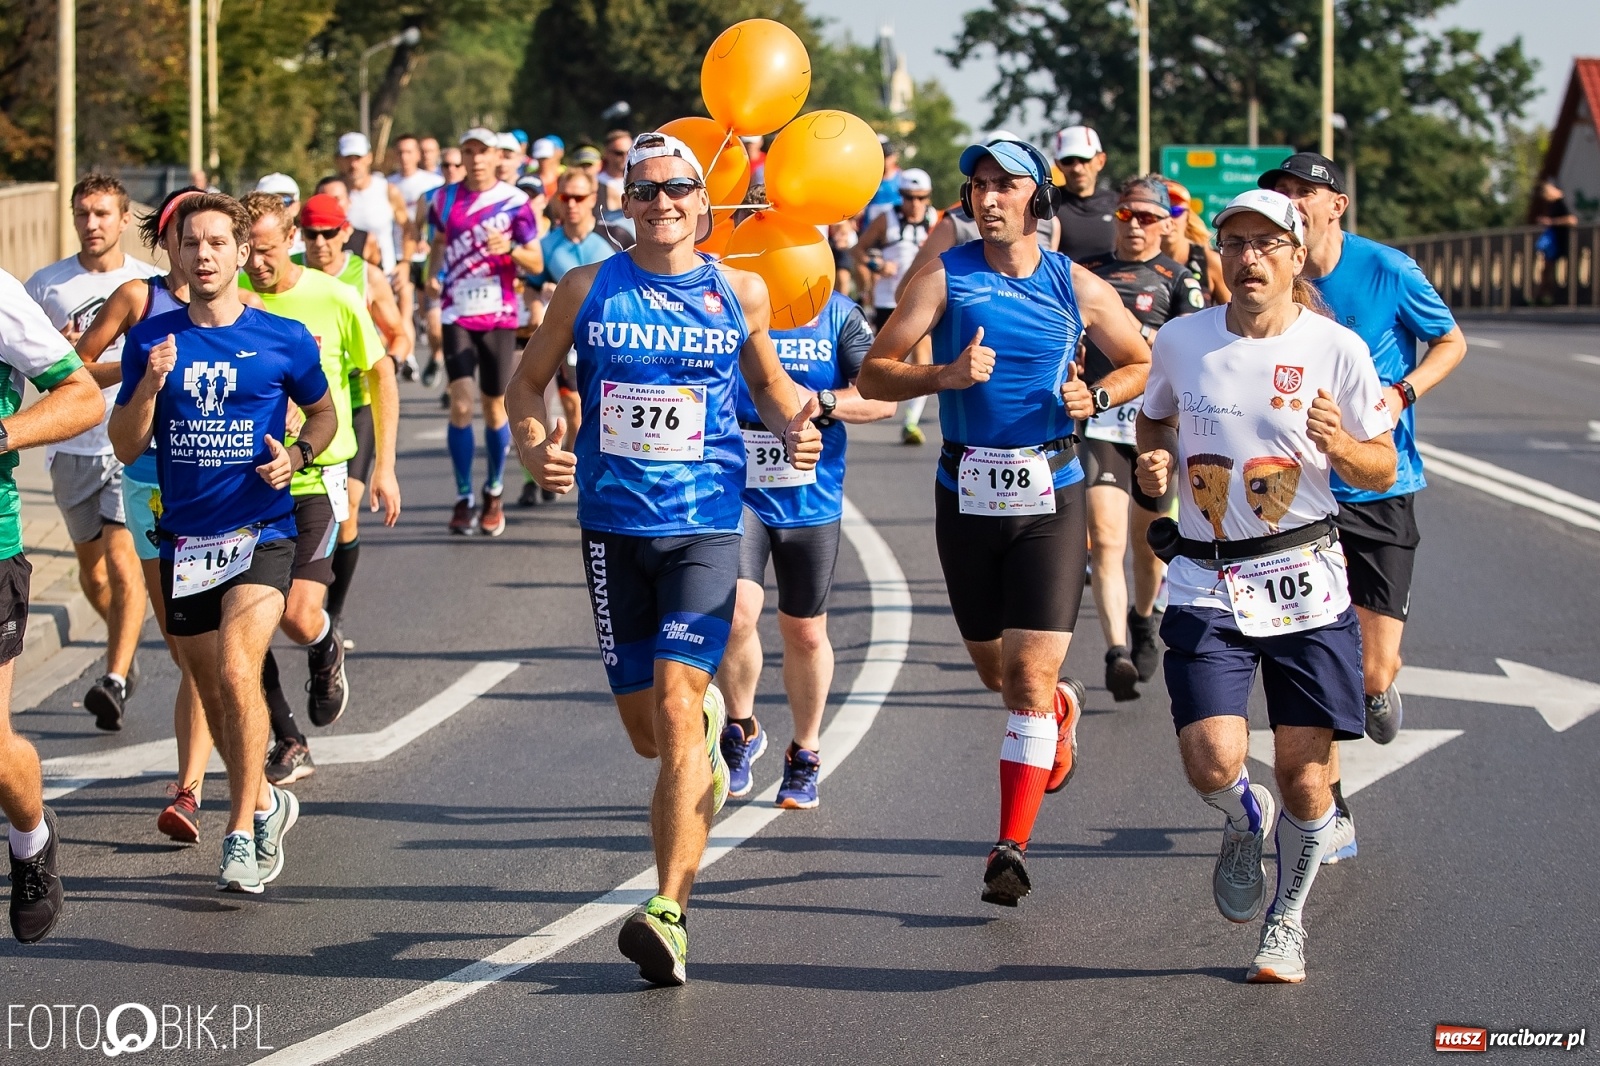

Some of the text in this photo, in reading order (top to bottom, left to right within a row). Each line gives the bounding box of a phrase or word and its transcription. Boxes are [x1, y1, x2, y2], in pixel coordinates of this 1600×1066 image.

[587, 321, 741, 355] RUNNERS
[680, 357, 714, 369] TEAM
[169, 419, 254, 432] 2nd WIZZ AIR
[630, 405, 680, 431] 376
[1192, 415, 1219, 437] III
[170, 433, 254, 448] KATOWICE
[171, 448, 253, 458] HALF MARATHON
[198, 459, 222, 467] 2019
[988, 467, 1031, 490] 198
[203, 545, 241, 571] 166
[1260, 557, 1291, 568] RAFAKO
[1264, 571, 1313, 603] 105
[588, 540, 618, 668] RUNNERS
[1281, 602, 1299, 611] ARTUR
[1285, 834, 1320, 901] Kalenji
